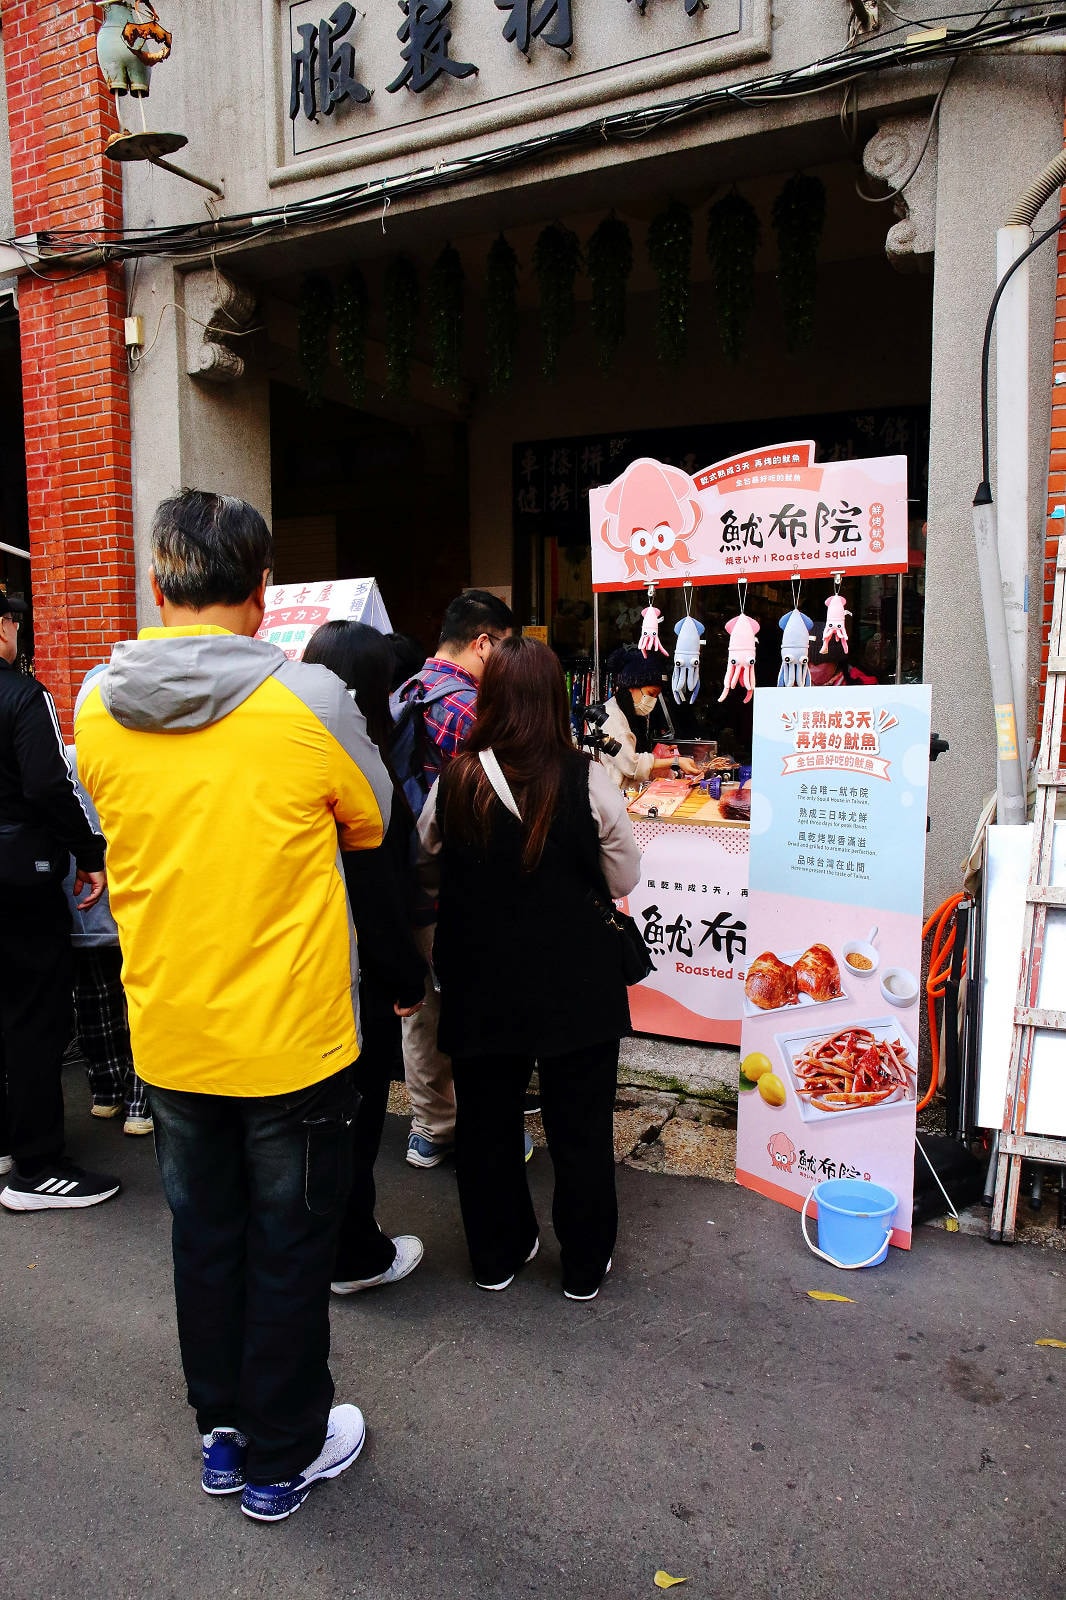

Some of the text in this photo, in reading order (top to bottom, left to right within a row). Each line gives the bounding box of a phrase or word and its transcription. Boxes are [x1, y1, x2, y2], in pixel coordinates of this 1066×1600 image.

[754, 454, 800, 468] 再烤的魷魚
[719, 500, 862, 553] 魷布院
[771, 547, 857, 562] Roasted squid
[271, 584, 333, 605] 名古屋
[796, 731, 876, 750] 再烤的魷魚
[797, 754, 874, 771] 全台最好吃的魷魚
[800, 783, 869, 799] 全台唯一魷布院
[799, 808, 868, 823] 熟成三日味尤鮮
[797, 854, 865, 873] 品味台灣在此間
[641, 904, 747, 972] 魷布
[675, 962, 733, 980] Roasted
